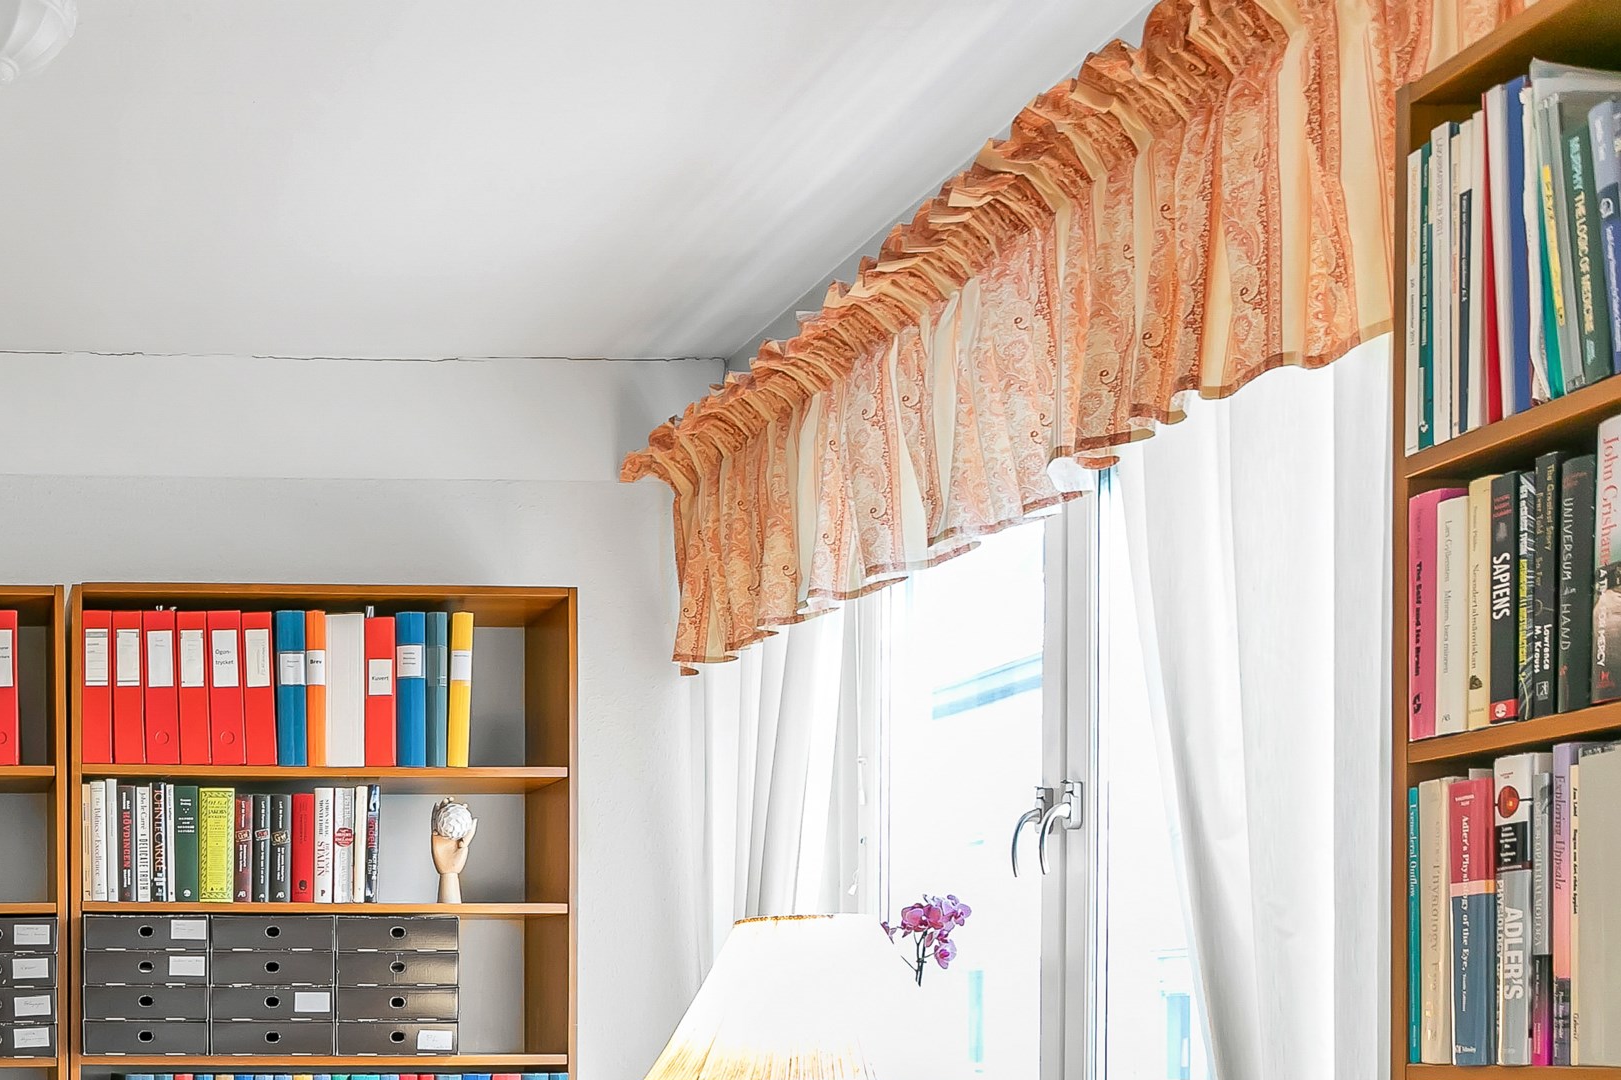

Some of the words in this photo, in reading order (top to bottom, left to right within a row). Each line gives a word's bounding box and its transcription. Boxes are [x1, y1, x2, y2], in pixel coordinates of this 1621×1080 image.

[1580, 274, 1594, 334] MEDICINE
[1602, 436, 1619, 481] John
[1561, 497, 1574, 581] UNIVERSUM
[1415, 561, 1423, 582] The
[1492, 552, 1510, 620] SAPIENS
[1560, 603, 1572, 651] HAND
[1534, 636, 1542, 674] Krauss
[1542, 624, 1552, 670] Lawrence
[1597, 630, 1607, 667] MERCY
[154, 789, 164, 822] JOHN
[1554, 774, 1566, 836] Exploring
[1461, 815, 1470, 851] Adler's
[139, 839, 148, 868] DELICATE
[317, 841, 325, 876] STALIN
[1554, 840, 1566, 891] Uppsala
[139, 871, 148, 890] TRUTH
[1409, 861, 1417, 897] Outflow
[1460, 854, 1470, 912] Physiology
[1461, 914, 1470, 926] of
[1461, 928, 1470, 945] the
[1461, 948, 1470, 971] Eye,
[1503, 907, 1524, 1000] ADLER'S
